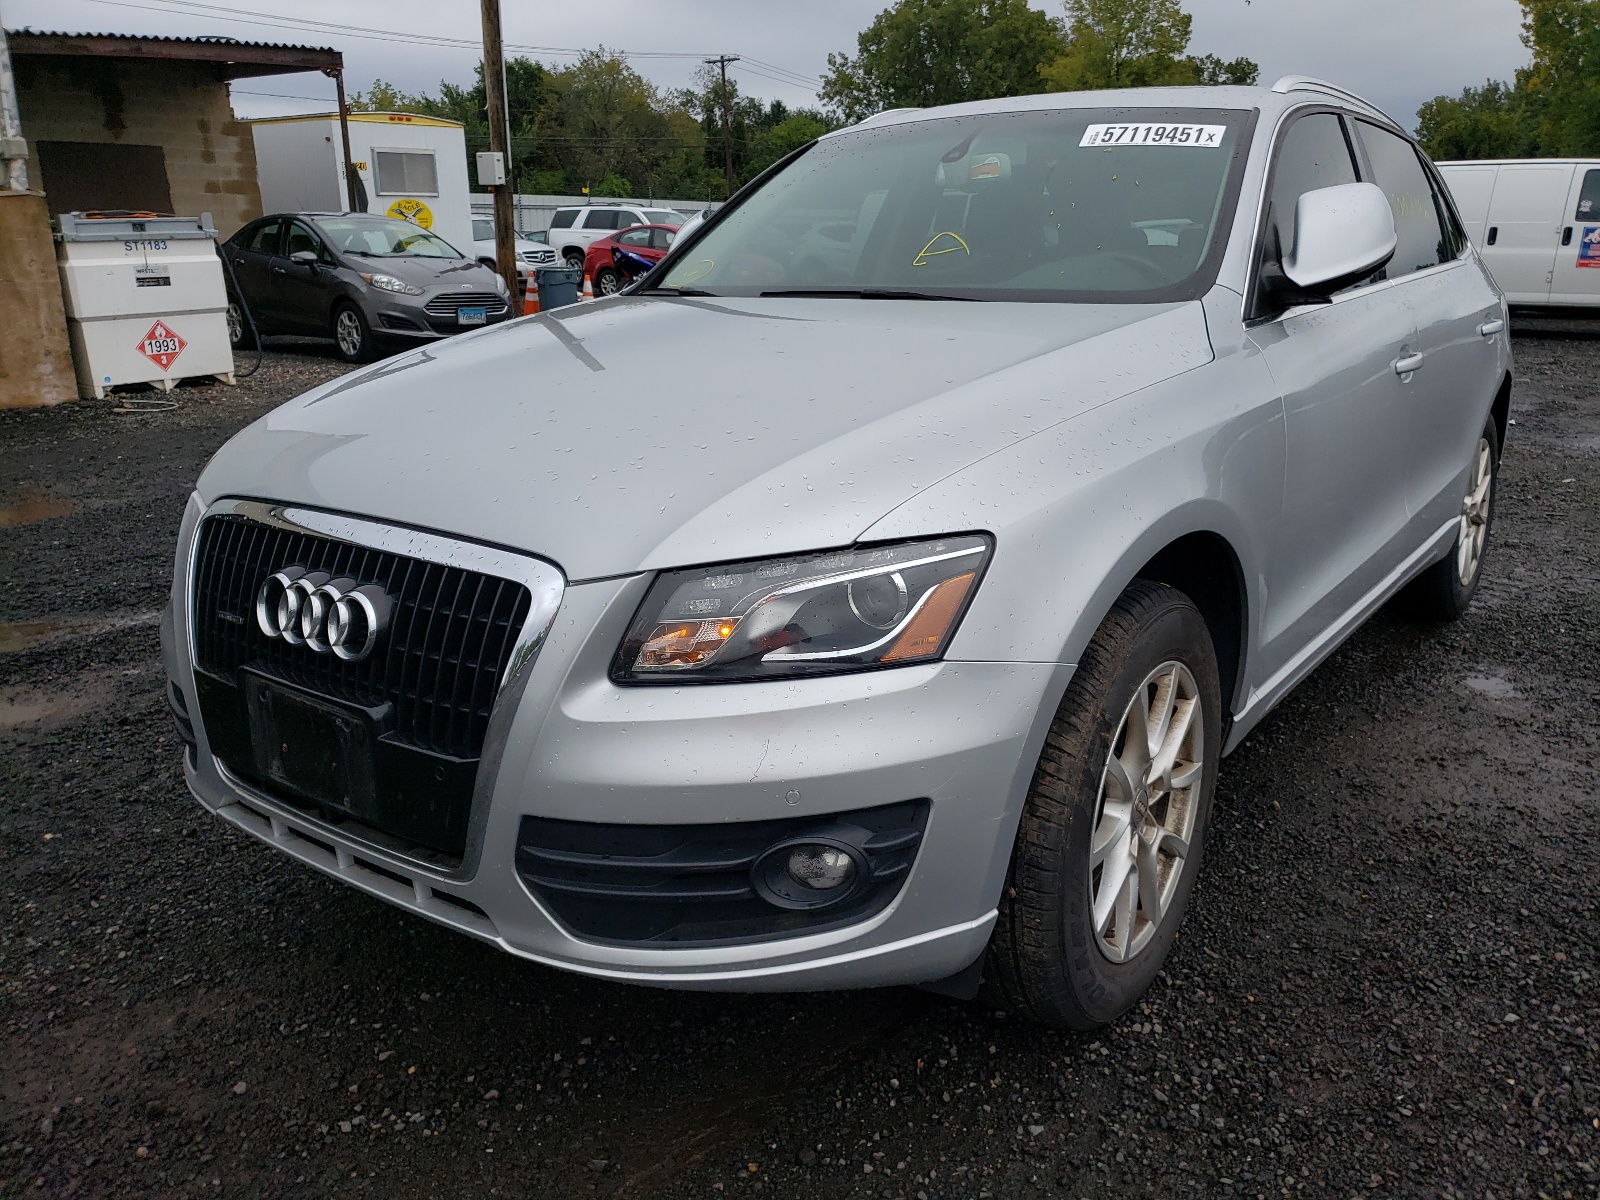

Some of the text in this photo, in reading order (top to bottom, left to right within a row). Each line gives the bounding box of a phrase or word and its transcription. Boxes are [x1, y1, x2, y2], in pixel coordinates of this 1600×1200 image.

[1101, 126, 1204, 144] 57119451
[124, 240, 168, 252] ST1183
[147, 338, 177, 353] 1993
[160, 355, 168, 365] 3
